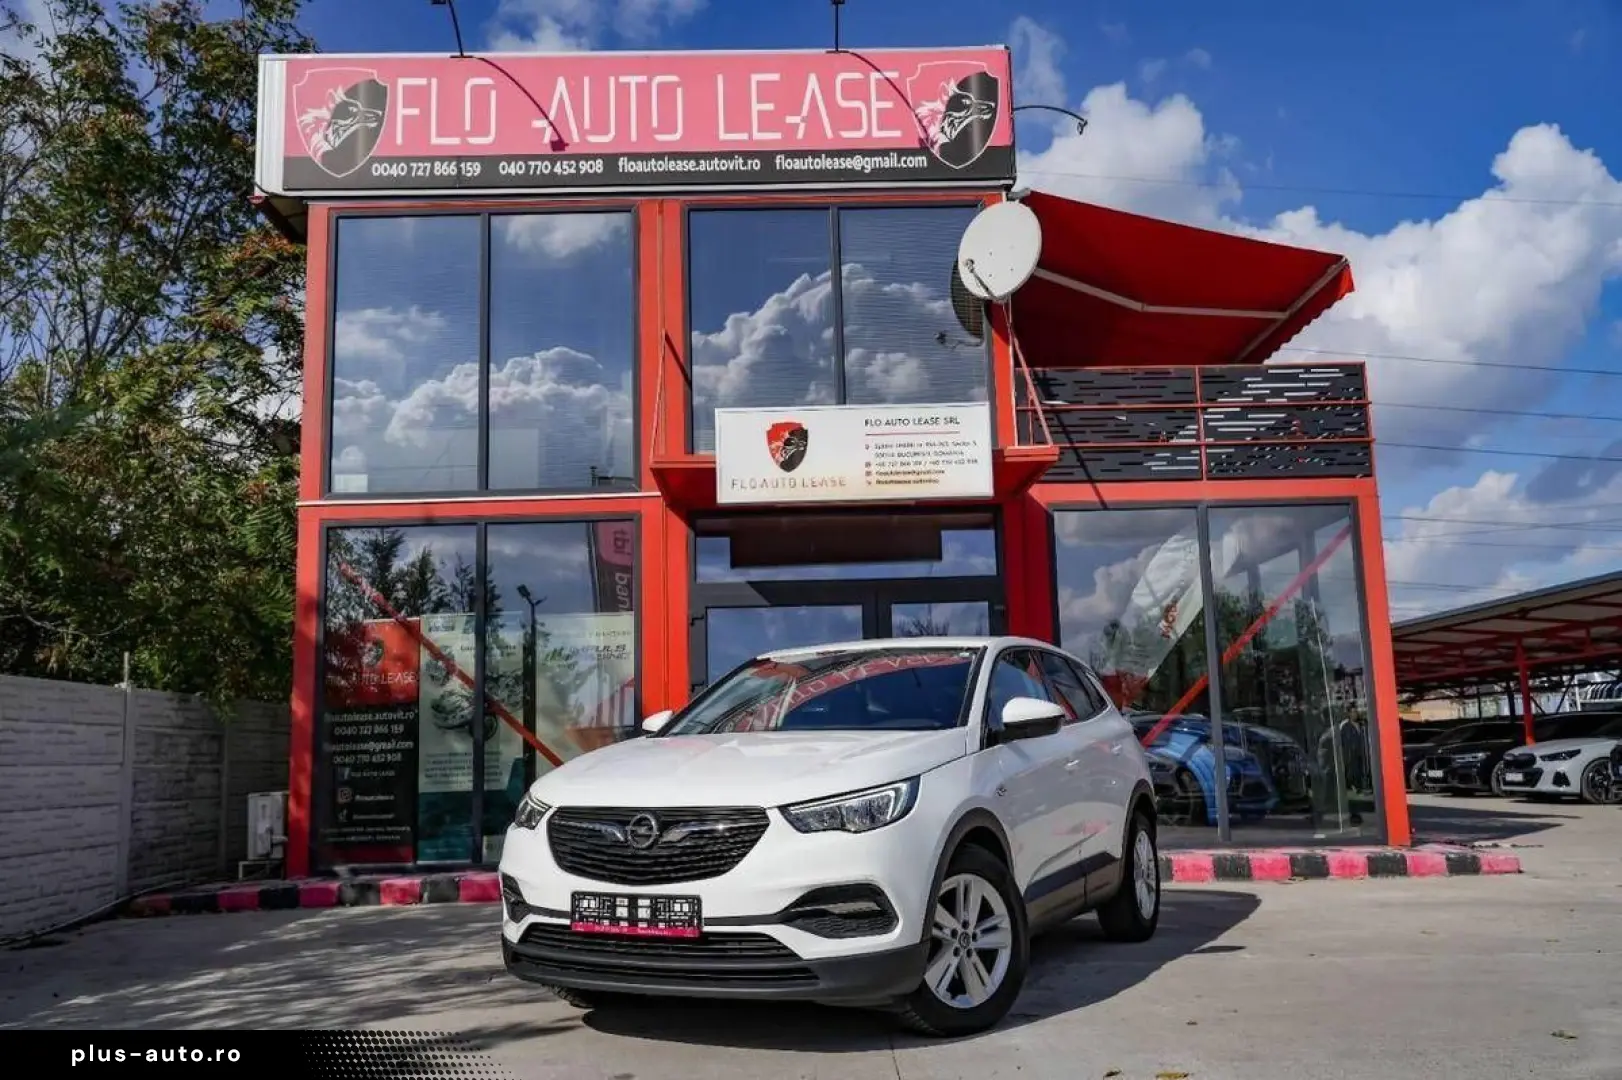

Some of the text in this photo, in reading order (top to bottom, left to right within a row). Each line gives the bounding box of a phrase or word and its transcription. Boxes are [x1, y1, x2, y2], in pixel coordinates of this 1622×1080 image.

[395, 71, 902, 146] FLO AUTO LEASE
[371, 161, 482, 177] 0040 727 866 159
[499, 159, 604, 176] 040 770 452 908
[617, 156, 761, 174] floautolease.autovit.ro
[775, 153, 928, 173] floautolease@gmail.com
[864, 416, 961, 427] FLO AUTO LEASE SRL
[801, 476, 847, 488] LEASE
[614, 572, 631, 612] ban
